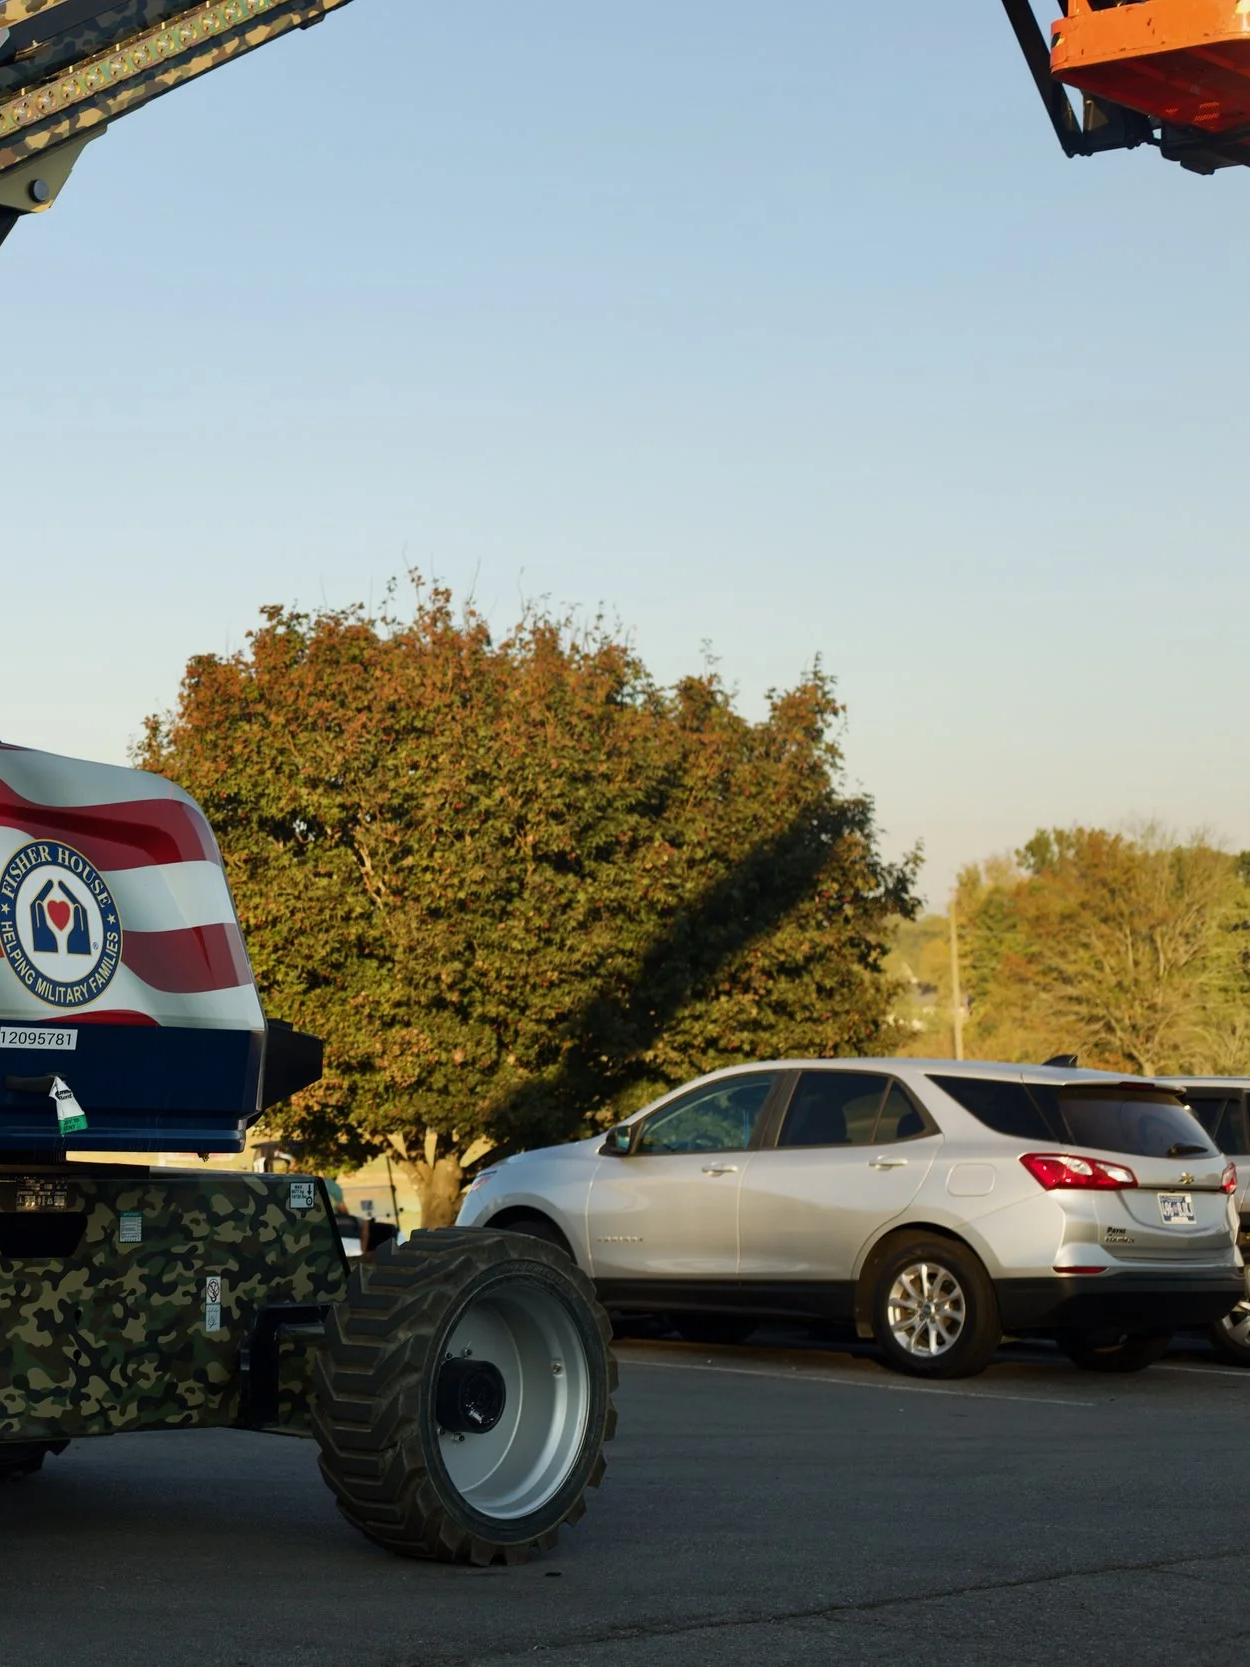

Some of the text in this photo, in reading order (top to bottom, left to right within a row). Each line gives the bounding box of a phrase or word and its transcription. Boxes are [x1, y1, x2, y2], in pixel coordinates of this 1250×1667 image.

[1, 845, 111, 909] FISHER HOUSE
[0, 921, 36, 985] HELPING
[35, 977, 89, 1004] MILITARY
[89, 931, 119, 994] FAMILIES
[0, 1031, 72, 1046] 12095781
